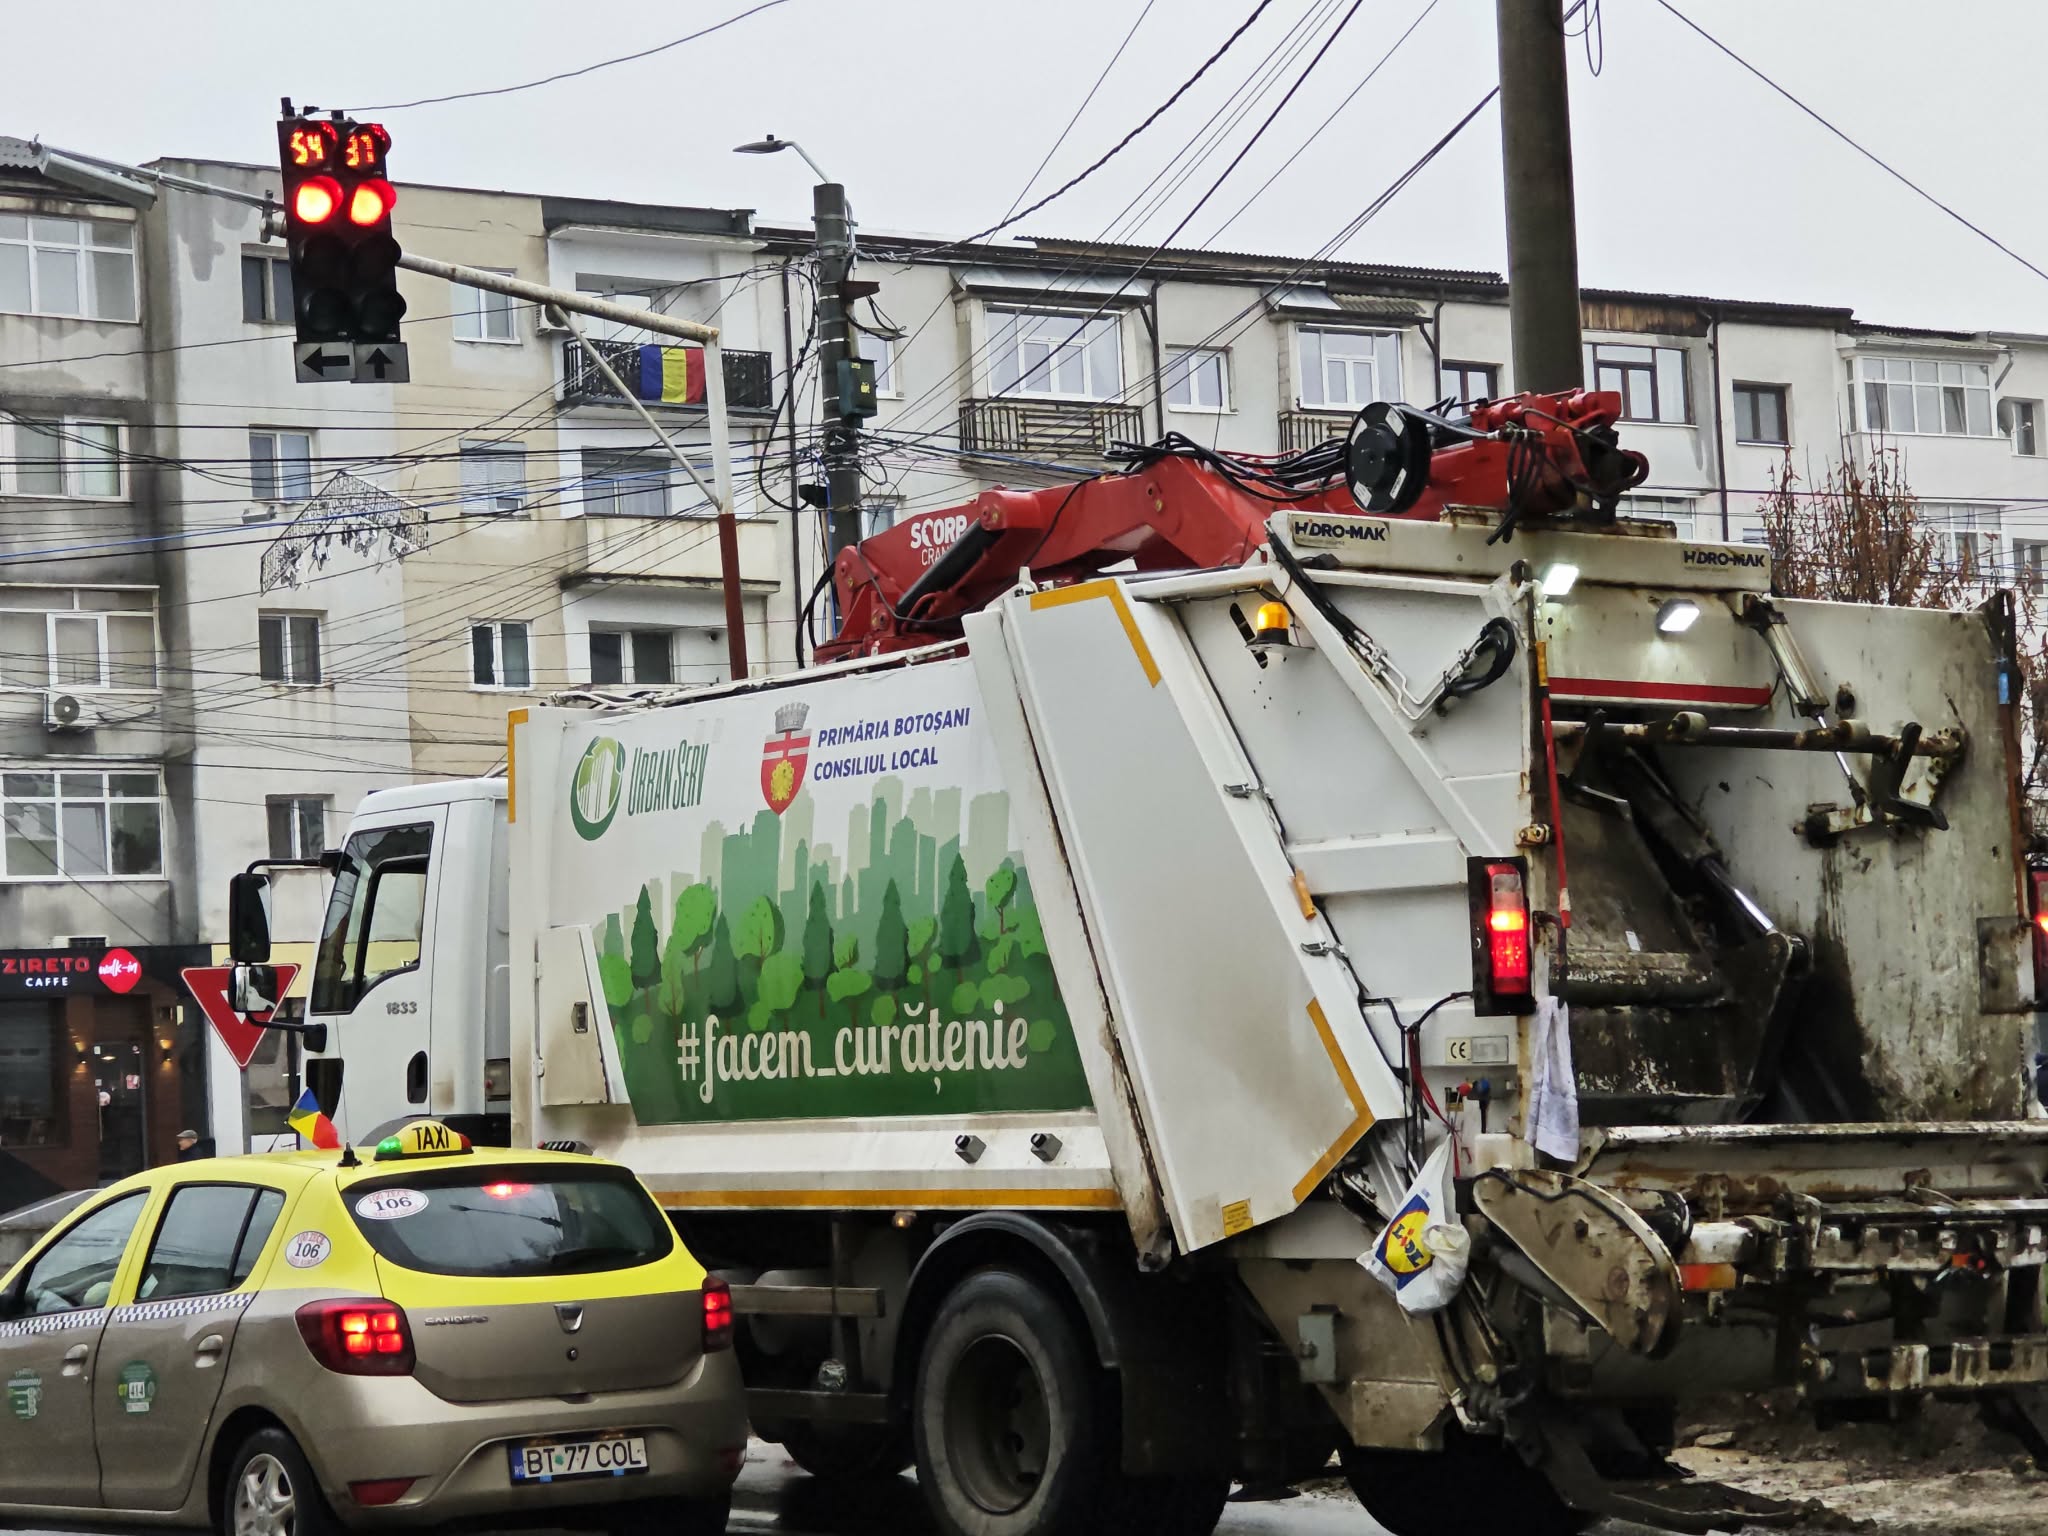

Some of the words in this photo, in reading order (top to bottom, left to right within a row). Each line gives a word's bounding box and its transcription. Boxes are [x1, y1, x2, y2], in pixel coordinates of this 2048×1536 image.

[290, 130, 324, 164] 54
[346, 134, 375, 166] 37
[910, 514, 968, 549] SCORP
[817, 718, 890, 748] PRIMĂRIA
[893, 707, 971, 736] BOTOȘANI
[813, 753, 887, 781] CONSILIUL
[891, 746, 938, 771] LOCAL
[2, 957, 90, 974] ZIRETO
[98, 958, 138, 977] walk-in
[25, 977, 69, 987] CAFFE
[386, 1001, 418, 1015] 1833
[1450, 1041, 1466, 1059] CE
[412, 1125, 450, 1151] TAXI
[374, 1196, 413, 1212] 106
[294, 1242, 321, 1259] 106
[526, 1448, 555, 1475] BT
[564, 1444, 590, 1471] 77
[595, 1440, 642, 1468] COL
